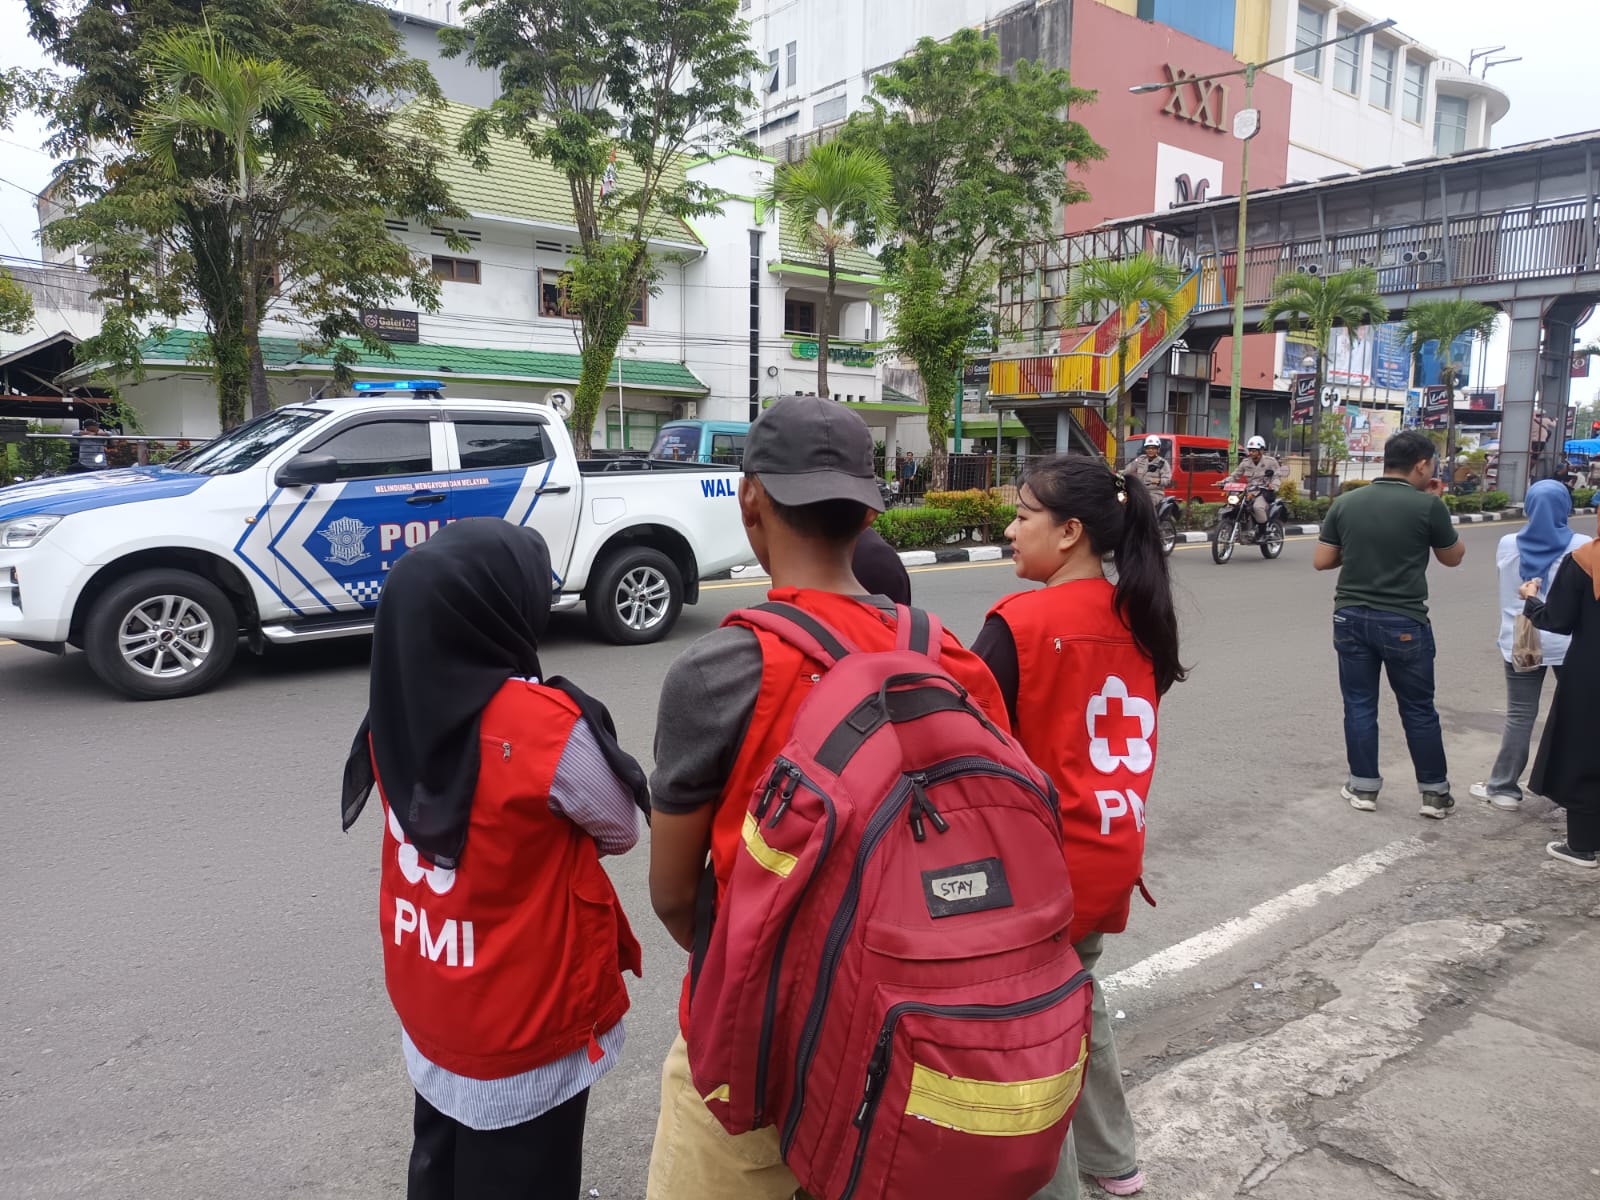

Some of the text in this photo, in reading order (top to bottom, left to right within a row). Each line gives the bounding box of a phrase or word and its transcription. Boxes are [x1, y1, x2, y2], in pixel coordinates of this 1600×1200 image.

[1162, 63, 1231, 133] XXI
[828, 347, 875, 363] egadaian
[701, 478, 736, 498] WAL
[941, 879, 973, 897] STAY
[394, 897, 475, 967] PMI
